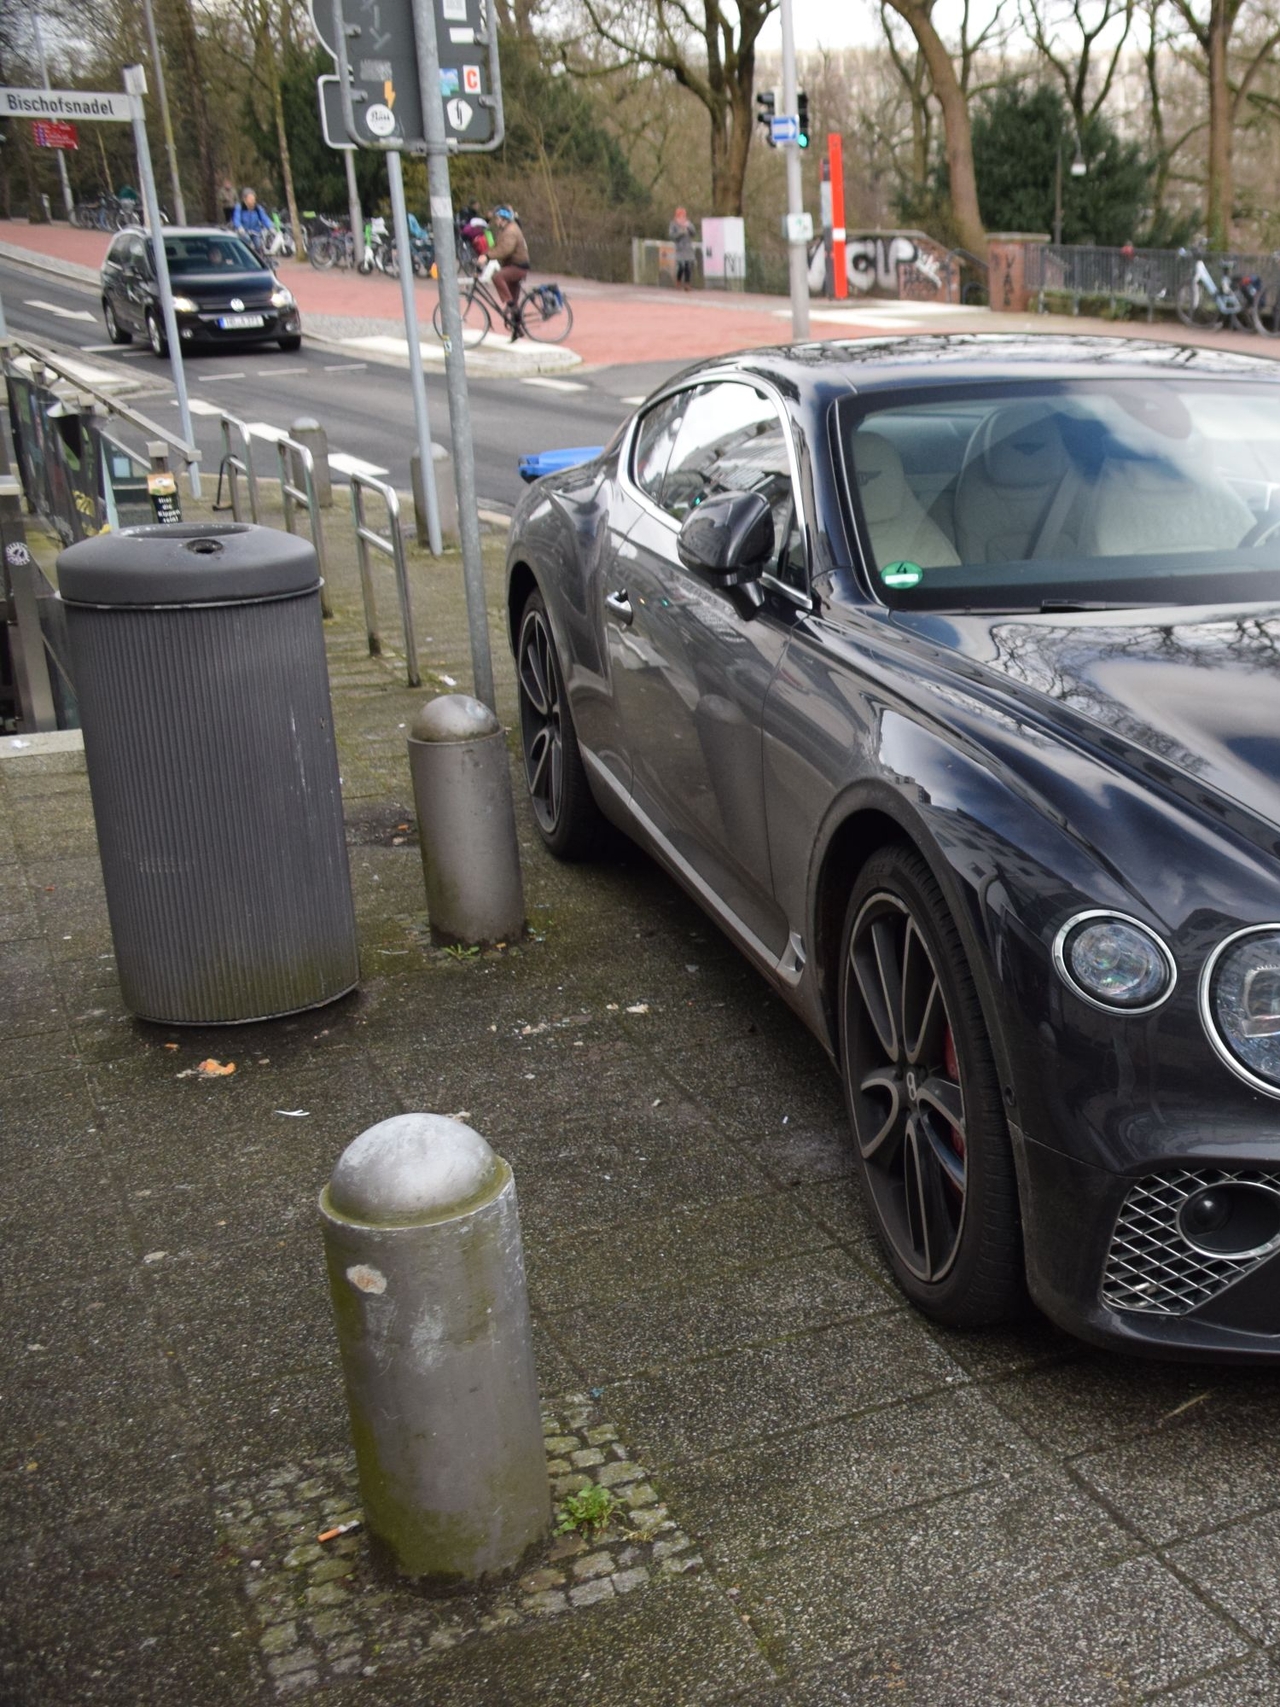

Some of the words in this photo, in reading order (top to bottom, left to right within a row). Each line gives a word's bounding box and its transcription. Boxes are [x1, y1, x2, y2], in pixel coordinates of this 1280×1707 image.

[466, 69, 478, 89] C
[7, 94, 115, 115] Bischofsnadel
[896, 562, 908, 574] 4
